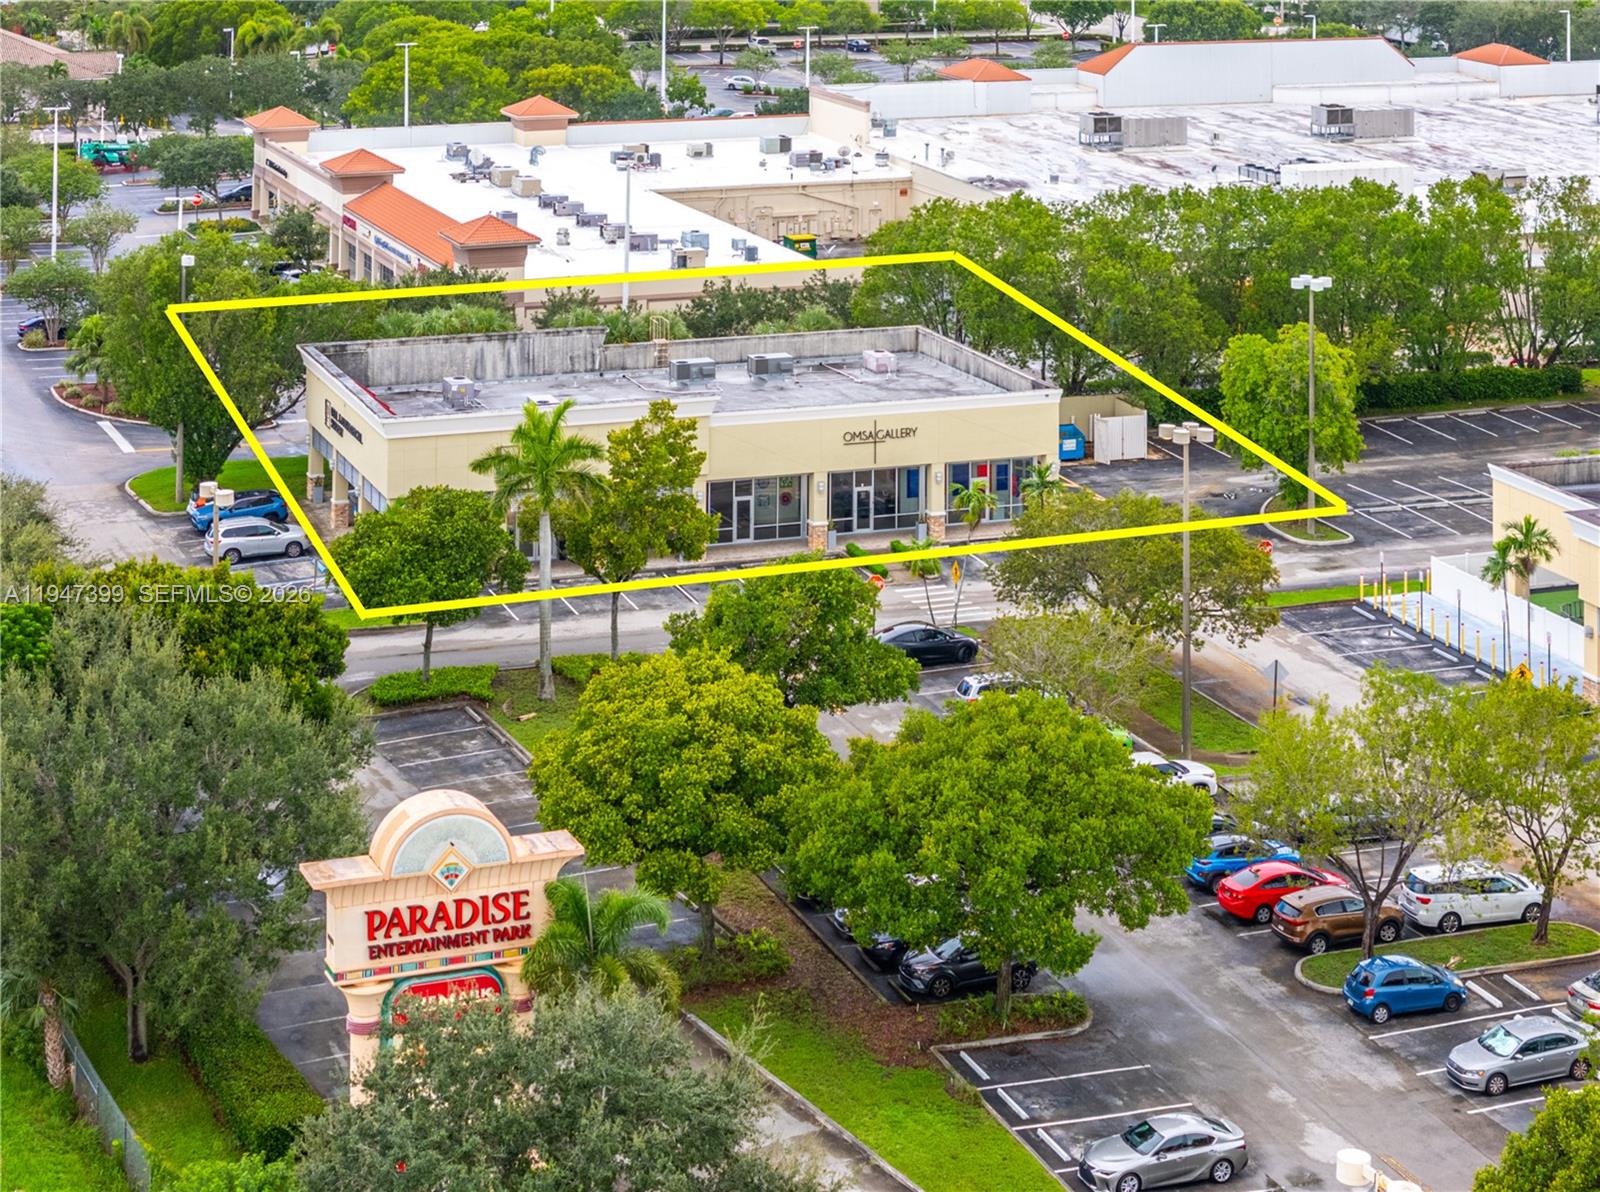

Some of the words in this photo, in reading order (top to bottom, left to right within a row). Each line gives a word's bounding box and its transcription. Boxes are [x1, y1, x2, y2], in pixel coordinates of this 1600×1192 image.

[843, 430, 874, 443] OMSA
[876, 427, 918, 440] GALLERY
[364, 889, 532, 942] PARADISE
[368, 929, 490, 961] ENTERTAINMENT
[493, 923, 532, 943] PARK
